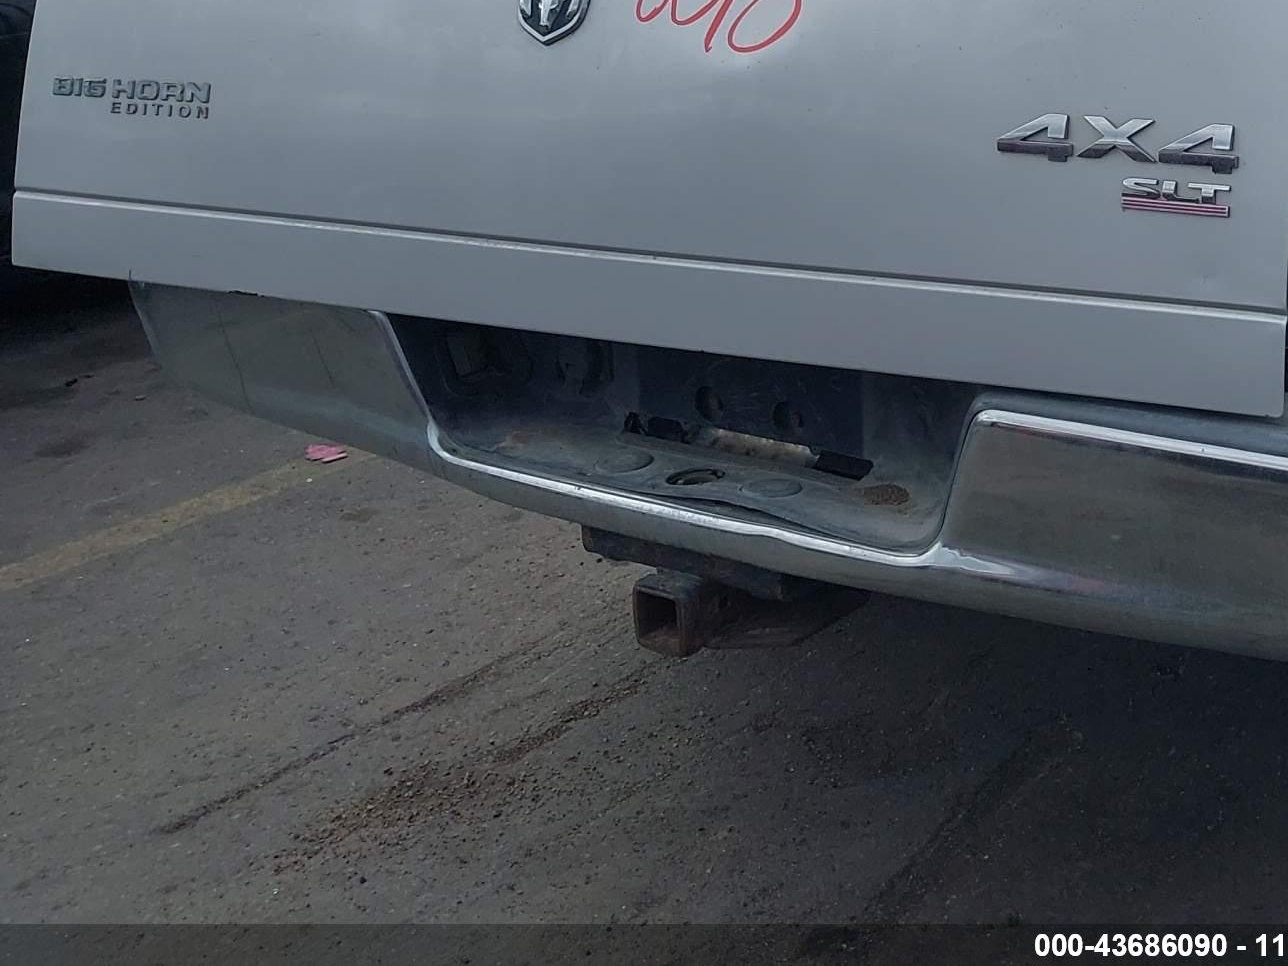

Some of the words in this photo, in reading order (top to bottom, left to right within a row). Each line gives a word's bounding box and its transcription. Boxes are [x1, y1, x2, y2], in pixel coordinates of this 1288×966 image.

[52, 77, 107, 98] BIG
[111, 79, 212, 103] HORN
[110, 102, 210, 119] EDITION
[996, 112, 1240, 175] 4X4
[1120, 177, 1232, 205] SLT
